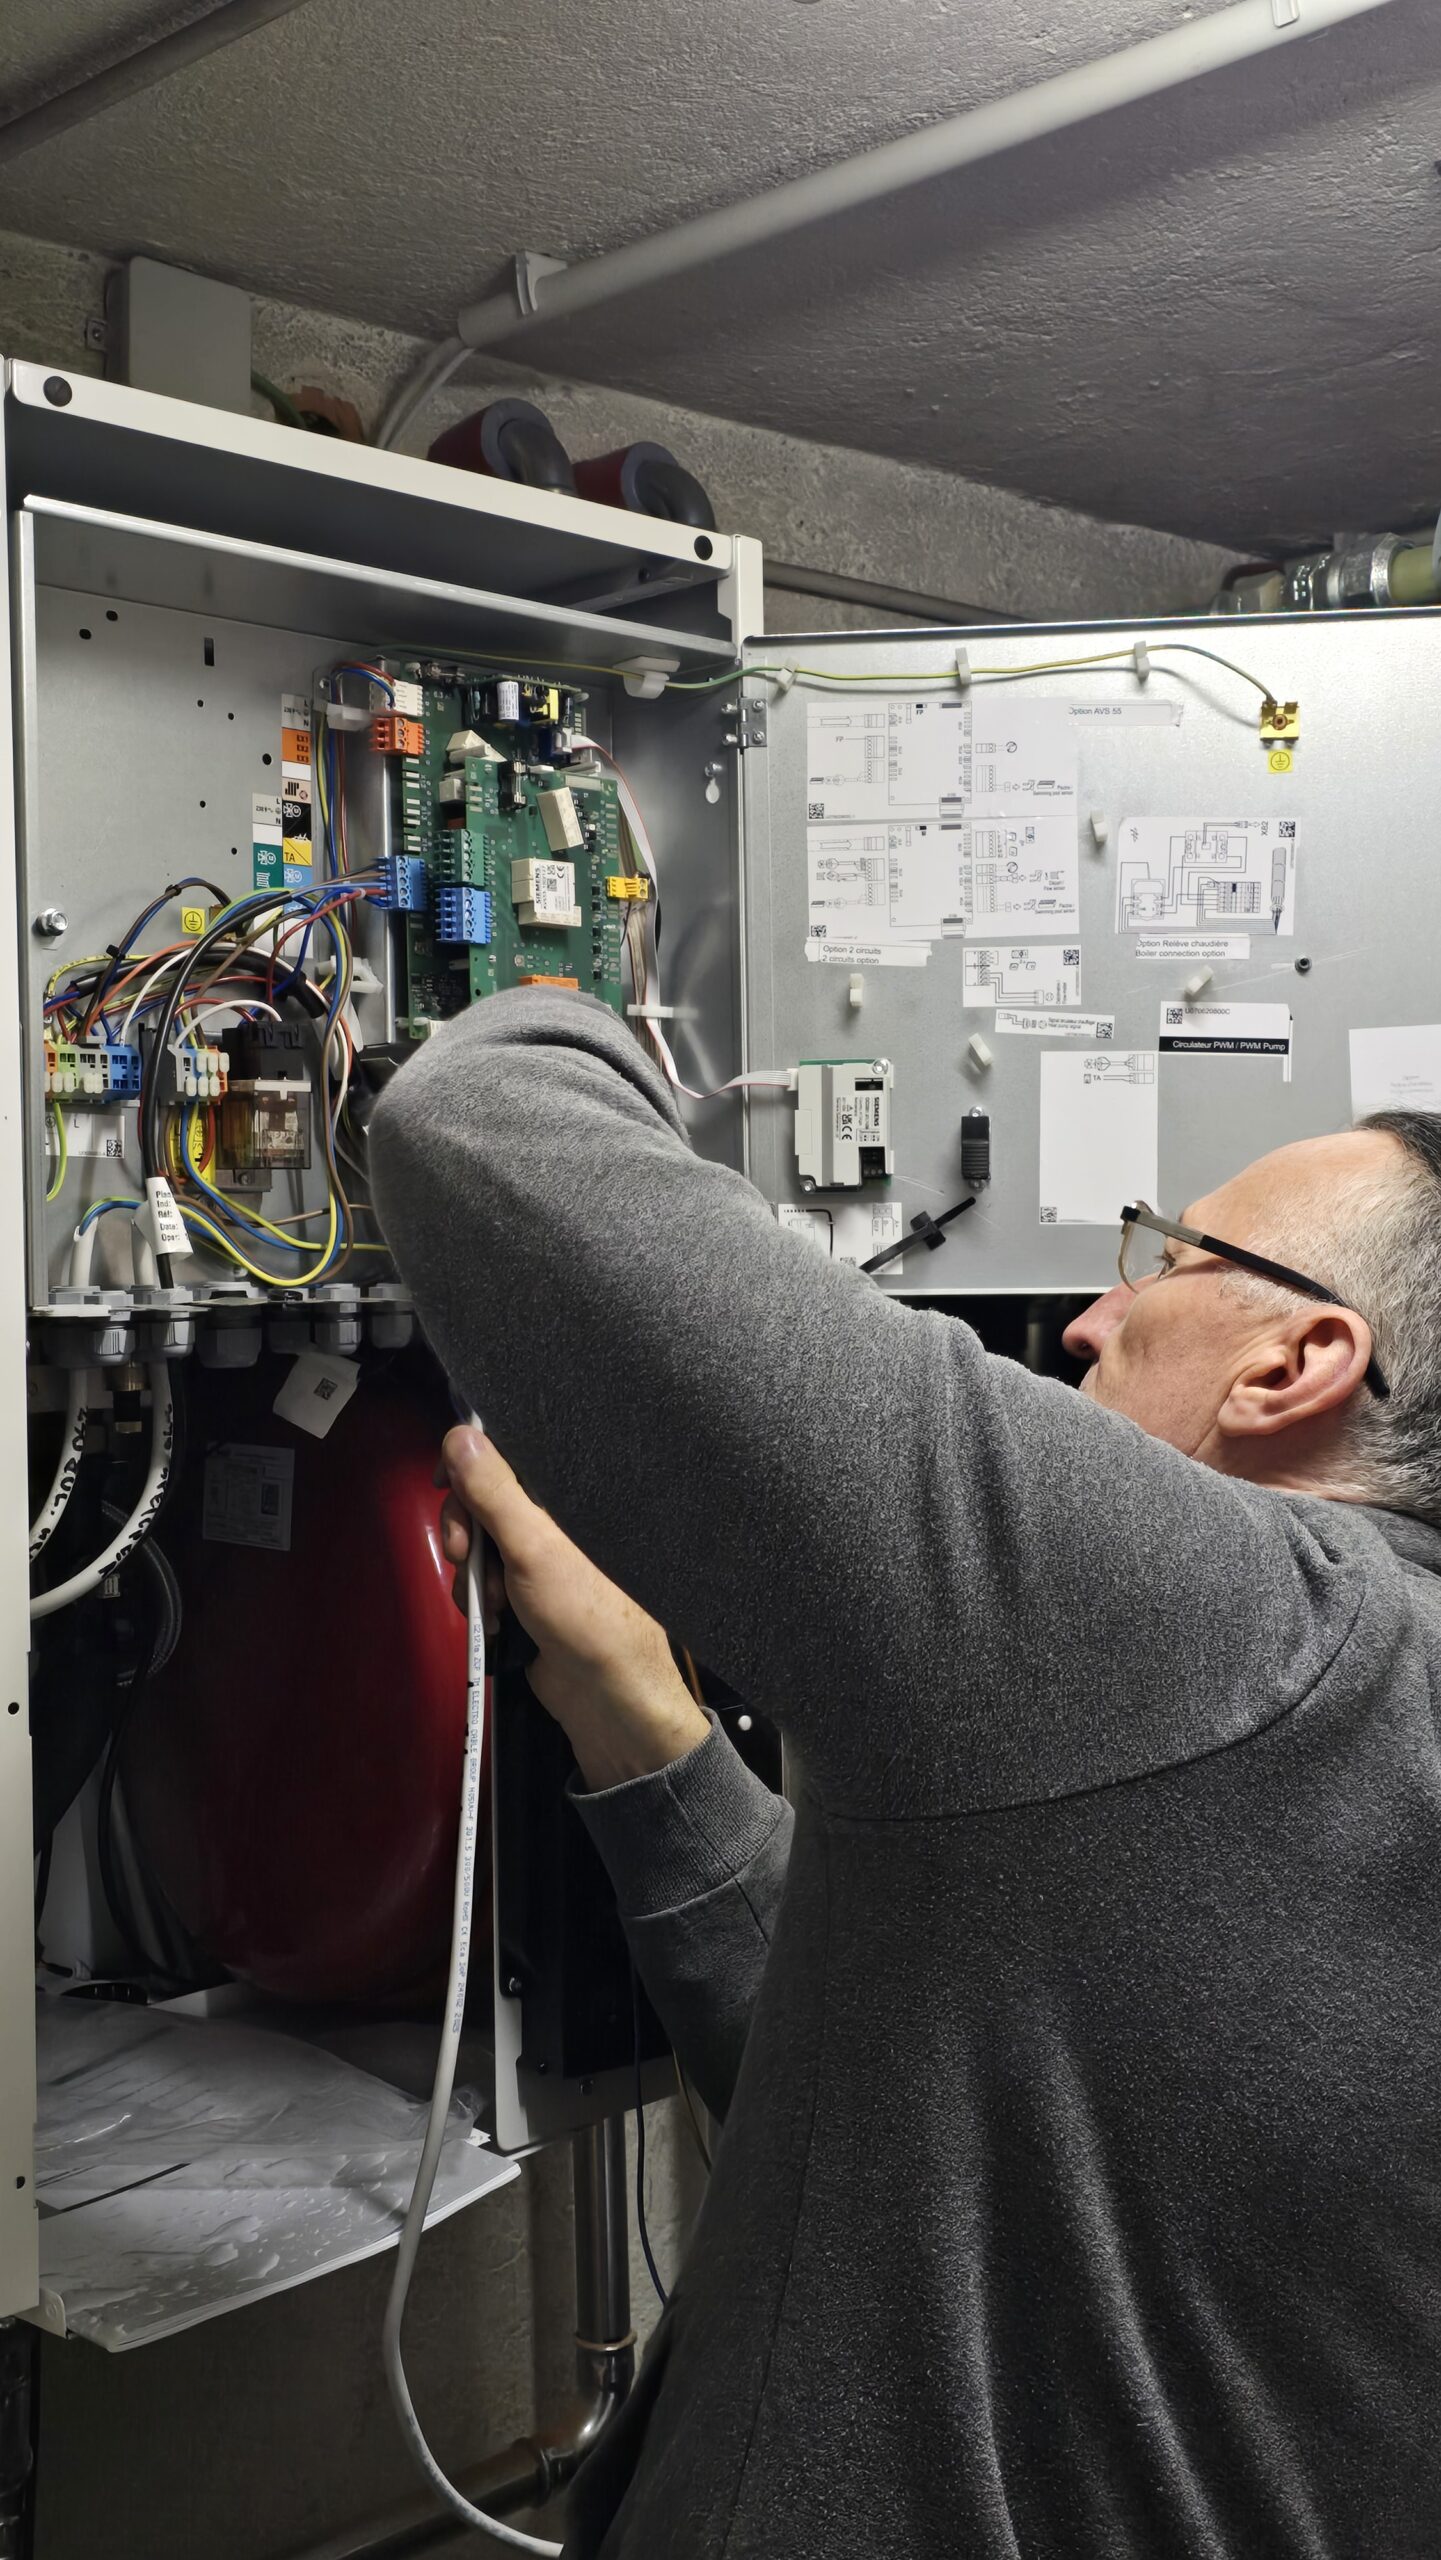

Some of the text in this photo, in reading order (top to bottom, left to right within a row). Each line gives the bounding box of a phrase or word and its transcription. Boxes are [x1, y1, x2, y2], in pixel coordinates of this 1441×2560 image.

[1094, 707, 1110, 715] AVS
[1112, 707, 1122, 715] 55
[1260, 821, 1269, 836] X82
[284, 852, 296, 863] TA
[823, 944, 848, 955] Option
[855, 946, 882, 955] circuits
[1135, 949, 1226, 959] Boiler connection option
[828, 955, 855, 963] circuits
[856, 957, 880, 965] option
[1172, 1040, 1212, 1048] Circulateur
[1213, 1041, 1234, 1049] PWM
[1262, 1043, 1286, 1051] Pump
[74, 1119, 80, 1129] L
[160, 1223, 179, 1231] Date:
[471, 1690, 480, 1725] ELECTRO
[470, 1729, 479, 1754] CABLE
[470, 1758, 478, 1783] GROUP
